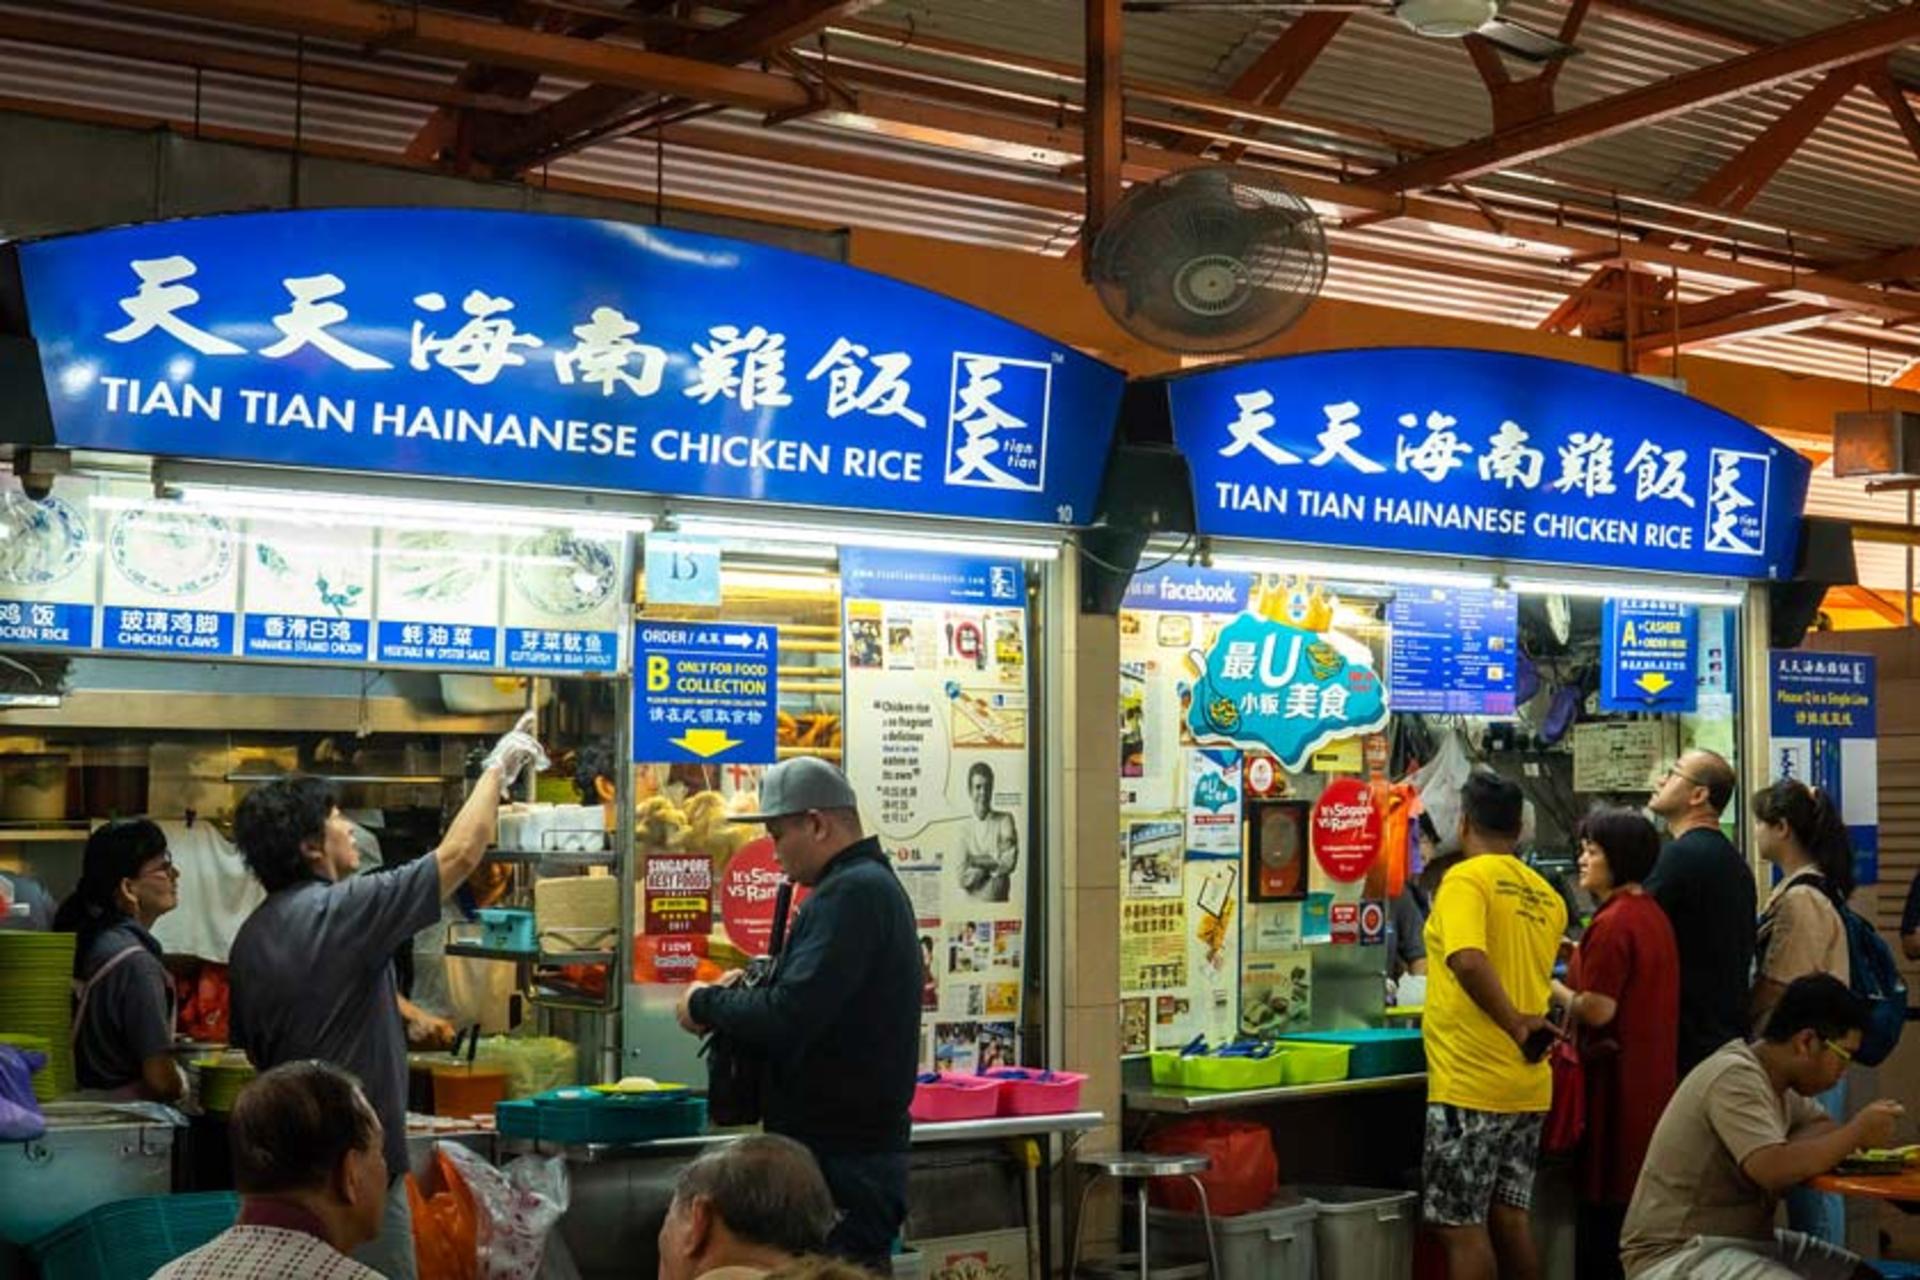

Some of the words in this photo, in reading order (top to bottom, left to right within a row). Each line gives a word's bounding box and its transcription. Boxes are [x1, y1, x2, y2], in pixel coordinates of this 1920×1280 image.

[104, 254, 926, 428] 天天海南雞飯
[101, 376, 221, 421] TIAN
[239, 389, 355, 432] TIAN
[373, 403, 637, 458] HAINANESE
[651, 430, 830, 475] CHICKEN
[843, 447, 922, 482] RICE
[1003, 438, 1033, 454] tian
[1218, 389, 1696, 509] 天天海南雞飯
[1007, 454, 1037, 469] tian
[1056, 504, 1073, 523] 10
[1216, 482, 1288, 514] TIAN
[1298, 490, 1365, 521] TIAN
[1374, 498, 1525, 535] HAINANESE
[1533, 512, 1638, 545] CHICKEN
[1644, 525, 1693, 550] RICE
[1160, 576, 1236, 604] facebook
[120, 610, 219, 635] 玻璃鸡脚
[1622, 620, 1636, 648] A
[41, 628, 69, 641] RICE
[118, 632, 173, 646] CHICKEN
[179, 635, 219, 649] CLAWS
[401, 624, 473, 647] 蚝油菜
[642, 630, 686, 643] ORDER
[756, 632, 768, 651] A
[676, 661, 707, 674] ONLY
[709, 662, 733, 674] FOR
[735, 663, 768, 676] FOOD
[1221, 632, 1302, 688] 最U
[647, 655, 670, 692] B
[676, 678, 767, 696] COLLECTION
[648, 859, 710, 873] SINGAPORE
